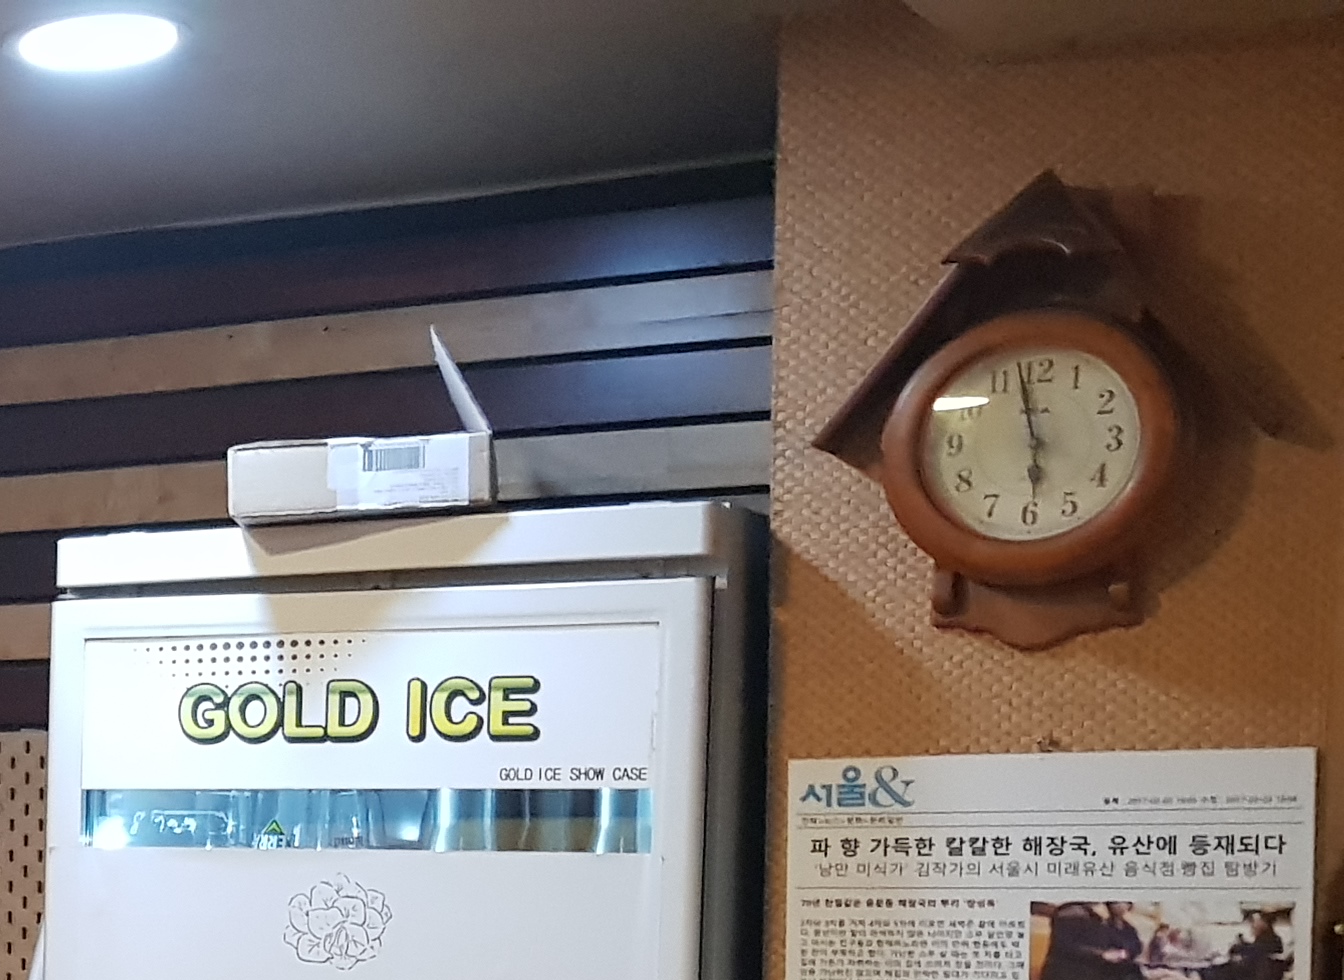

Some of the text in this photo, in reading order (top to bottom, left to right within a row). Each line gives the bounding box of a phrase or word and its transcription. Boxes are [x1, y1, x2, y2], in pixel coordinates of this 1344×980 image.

[990, 369, 1010, 394] 11
[1069, 364, 1082, 390] 1
[1096, 390, 1116, 416] 2
[946, 433, 964, 458] 9
[1105, 426, 1124, 453] 3
[954, 467, 974, 493] 8
[1090, 463, 1110, 488] 4
[982, 493, 1001, 519] 7
[1020, 501, 1039, 527] 6
[1060, 491, 1079, 518] 5
[178, 676, 541, 745] GOLD ICE
[499, 766, 648, 782] GOLD ICE SHOW CASE
[809, 833, 1287, 859] 파 향 가득한 칼칼한 해장국, 유산에 등재되다
[916, 860, 981, 879] 김작가의
[988, 860, 1039, 878] 서울시
[1046, 860, 1115, 878] 미래유산
[1224, 859, 1277, 879] 탐방기
